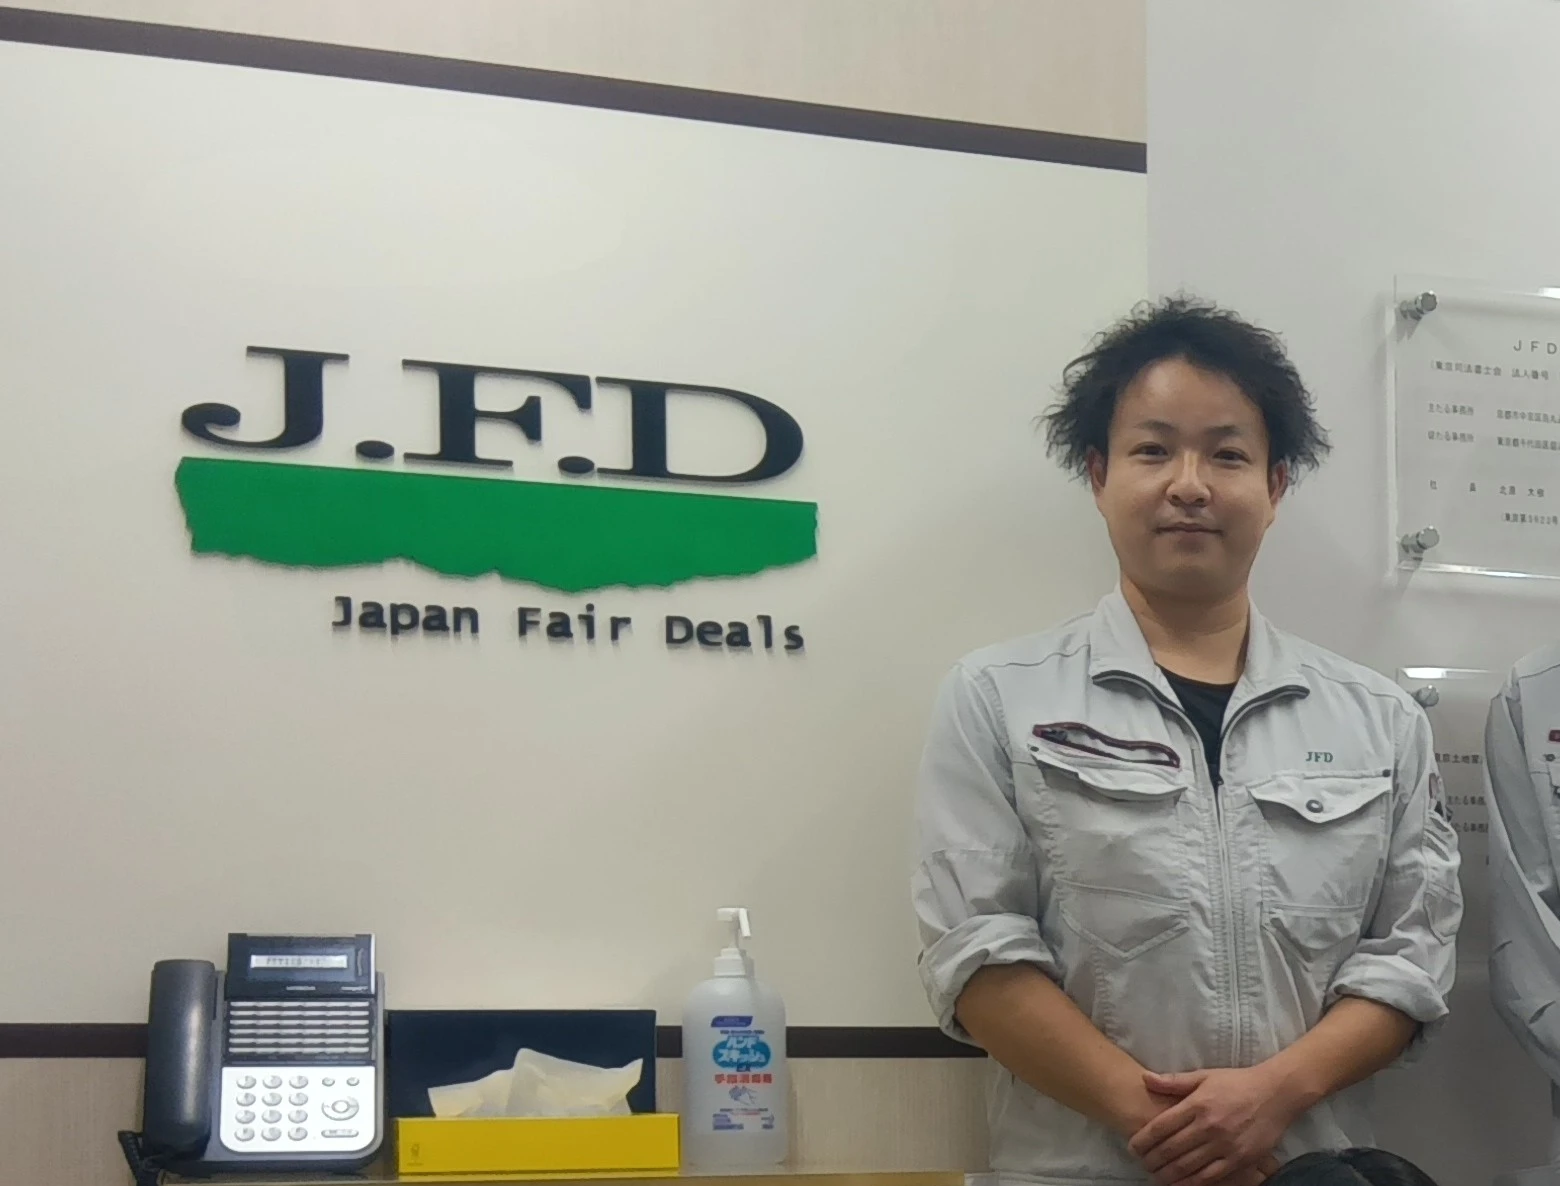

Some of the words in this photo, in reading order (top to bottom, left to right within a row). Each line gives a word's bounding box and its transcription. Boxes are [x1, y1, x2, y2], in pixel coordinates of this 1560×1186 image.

[181, 346, 805, 484] J.F.D
[332, 596, 480, 636] Japan
[517, 604, 632, 642] Fair
[665, 614, 805, 652] Deals
[1305, 751, 1334, 763] JFD
